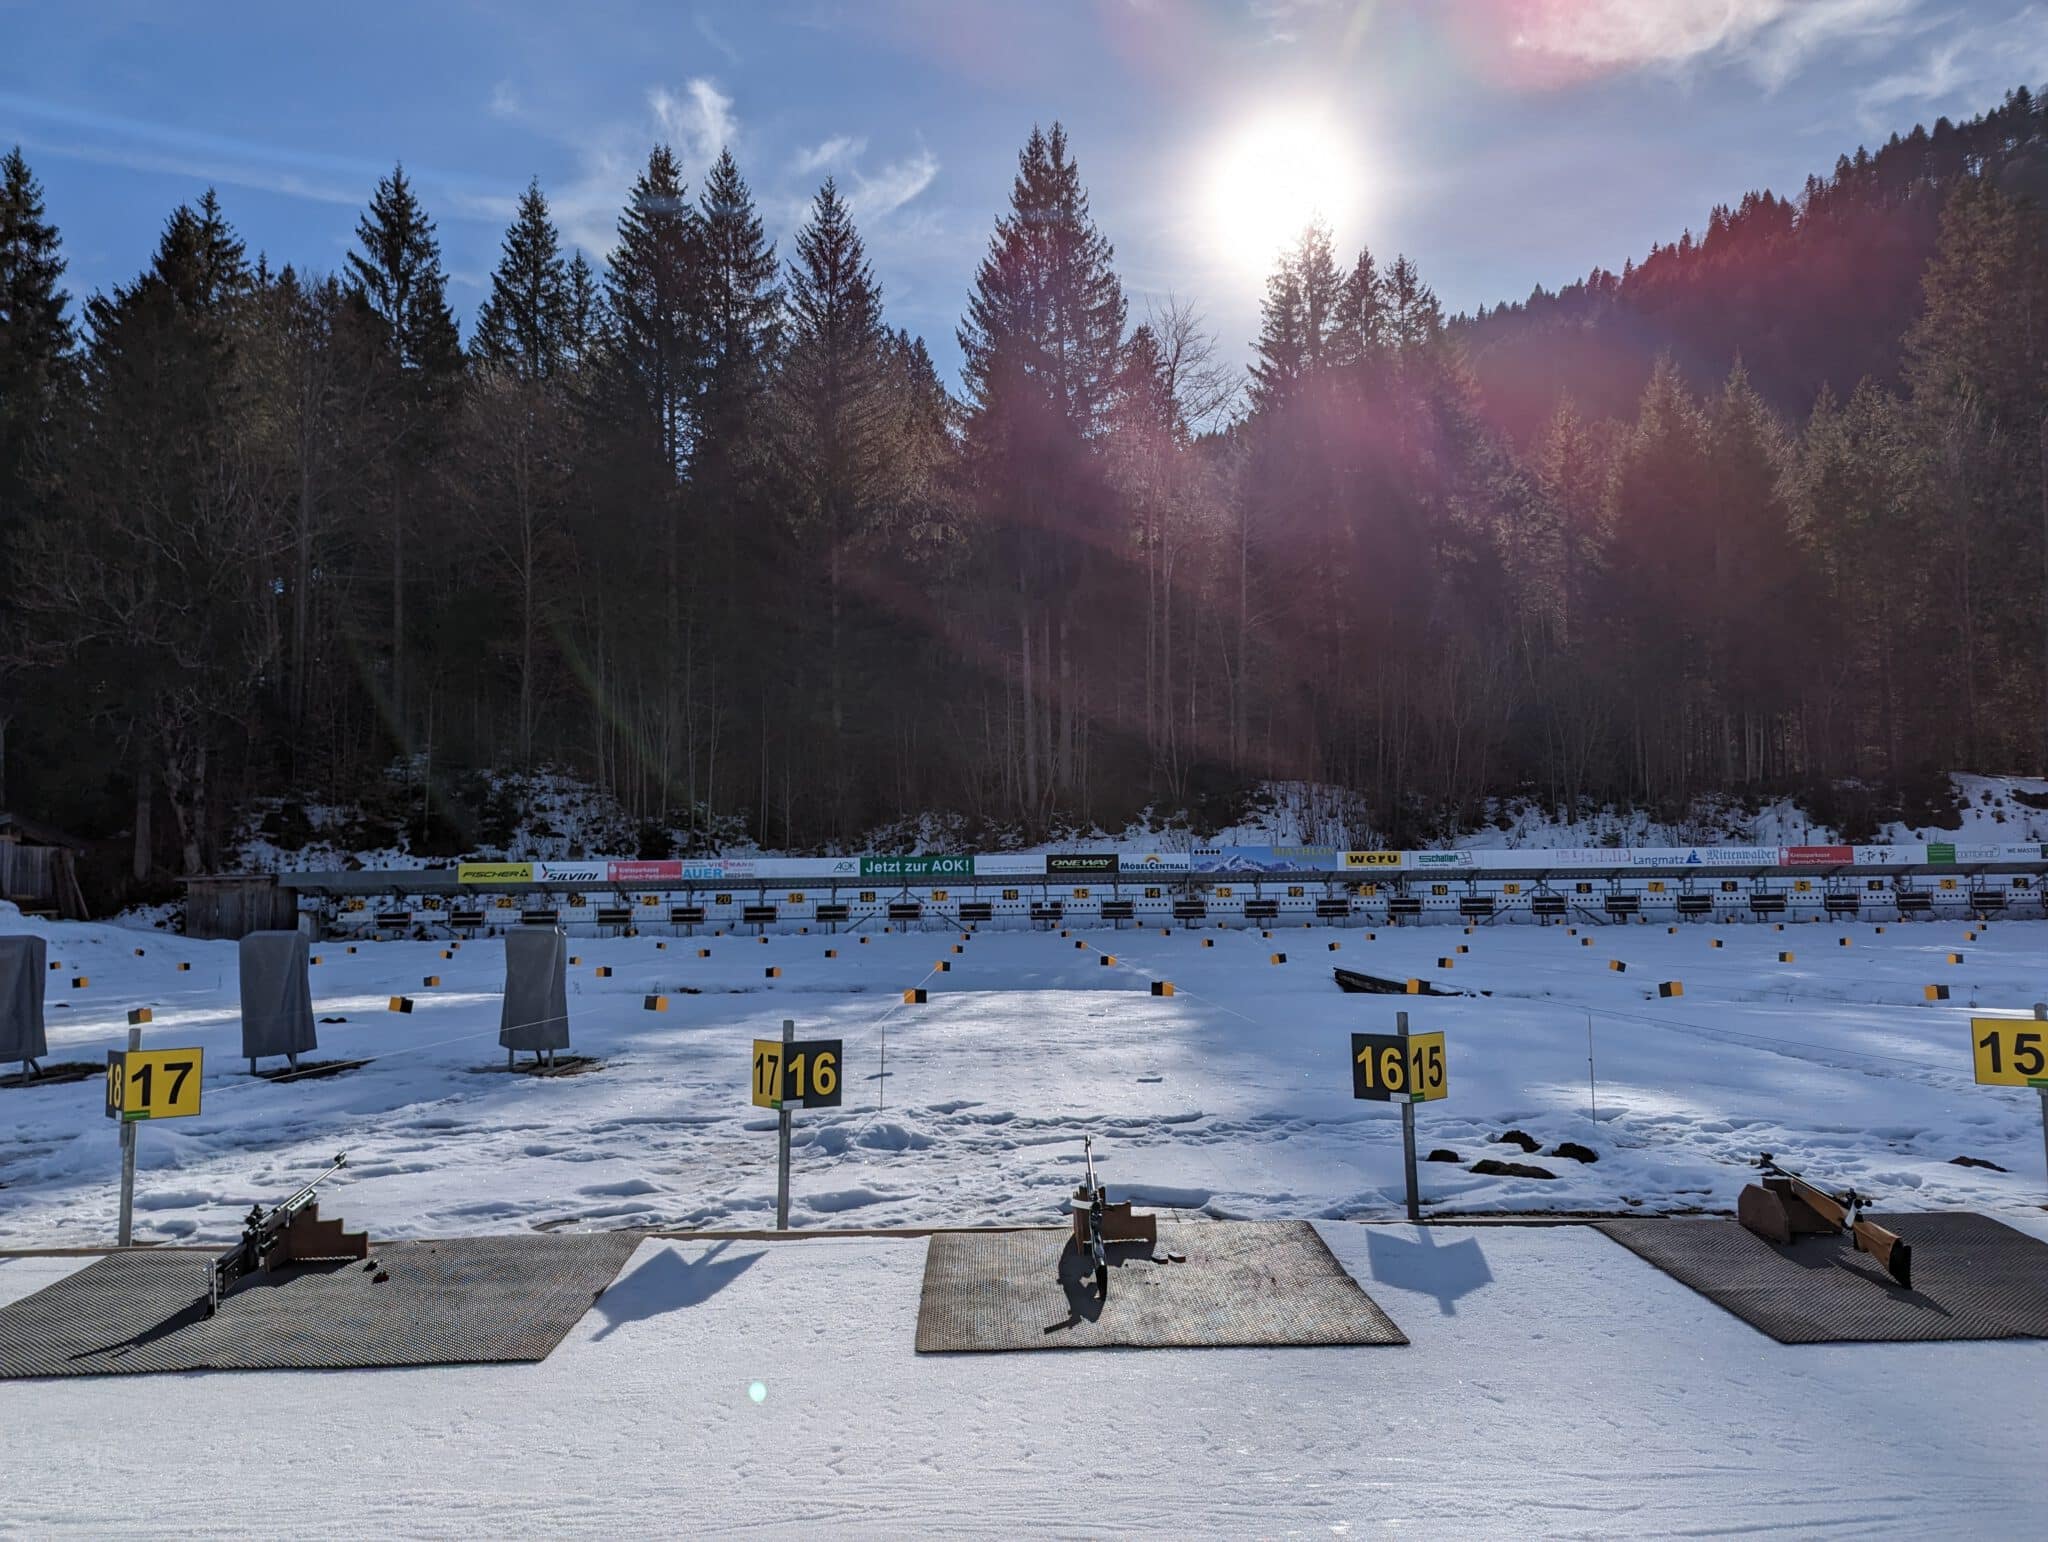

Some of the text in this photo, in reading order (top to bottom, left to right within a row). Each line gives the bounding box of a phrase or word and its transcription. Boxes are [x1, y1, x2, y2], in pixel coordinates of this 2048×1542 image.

[548, 872, 599, 880] SILVINI
[684, 868, 722, 879] AUER
[866, 861, 901, 873] Jetzt
[905, 863, 928, 872] zur
[932, 860, 970, 872] AOK!
[1350, 854, 1398, 863] weru
[1633, 856, 1685, 867] Langmatz
[755, 1052, 779, 1096] 17
[788, 1051, 837, 1097] 16
[1357, 1045, 1404, 1091] 16
[1412, 1046, 1443, 1090] 15
[1979, 1031, 2045, 1076] 15
[107, 1063, 122, 1108] 18
[131, 1061, 194, 1107] 17
